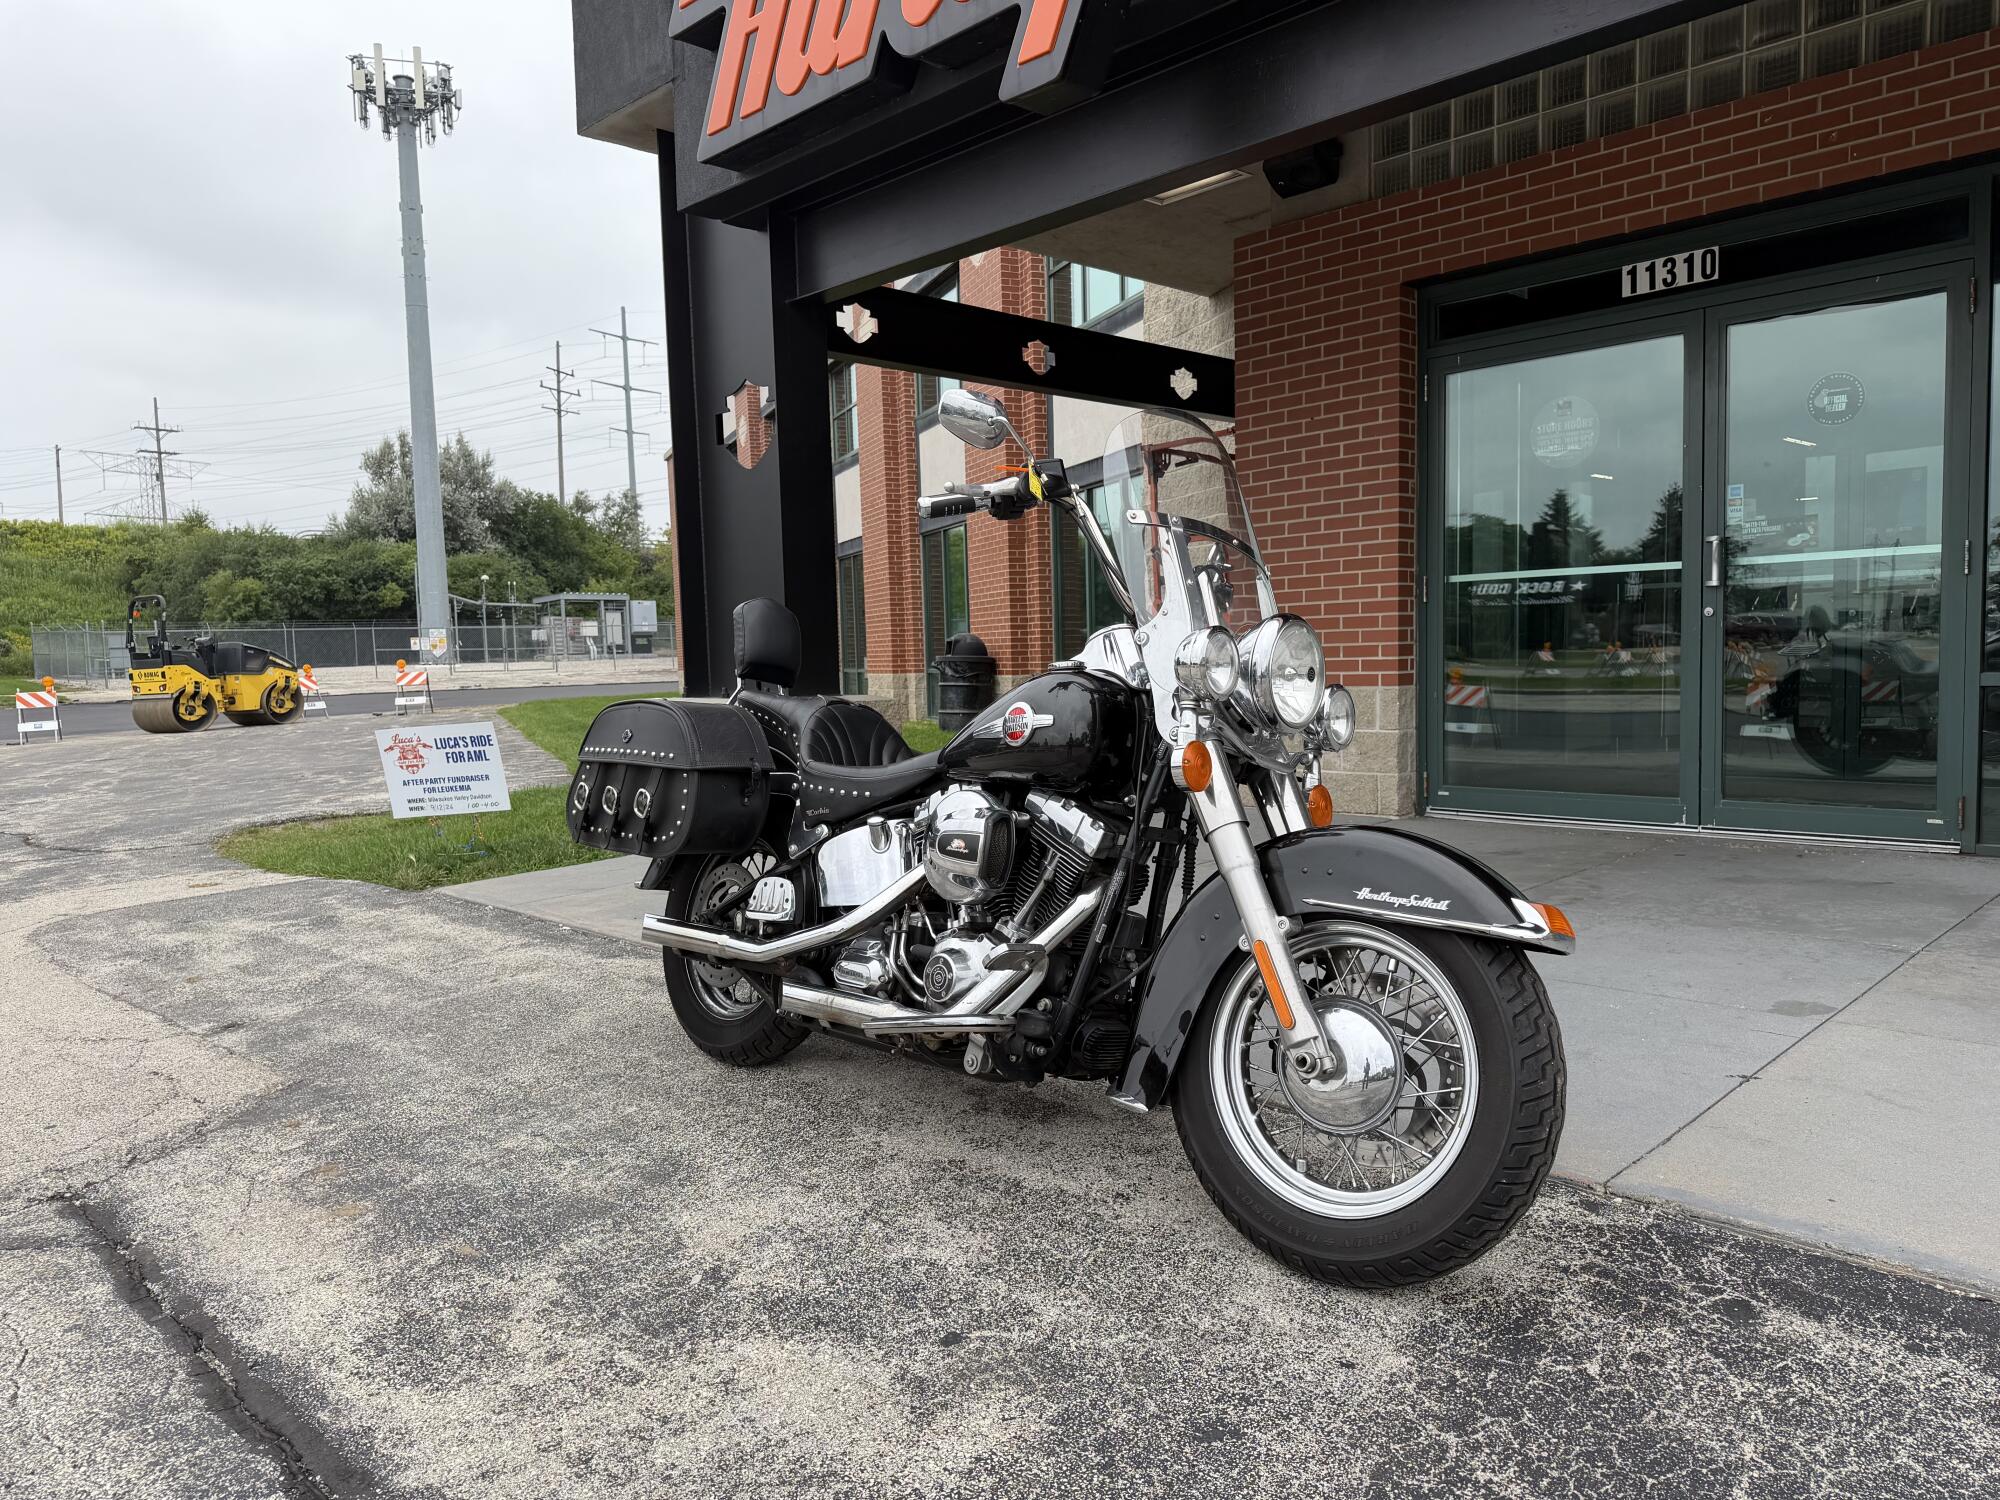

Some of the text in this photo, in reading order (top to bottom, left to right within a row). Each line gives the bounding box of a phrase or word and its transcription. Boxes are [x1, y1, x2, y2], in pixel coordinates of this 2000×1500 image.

[1626, 248, 1717, 295] 11310
[434, 735, 494, 750] LUCA'S RIDE
[445, 750, 490, 764] FOR AML
[402, 775, 490, 787] AFTER PARTY FUNDRAISER
[437, 785, 472, 793] LEUKEMIA
